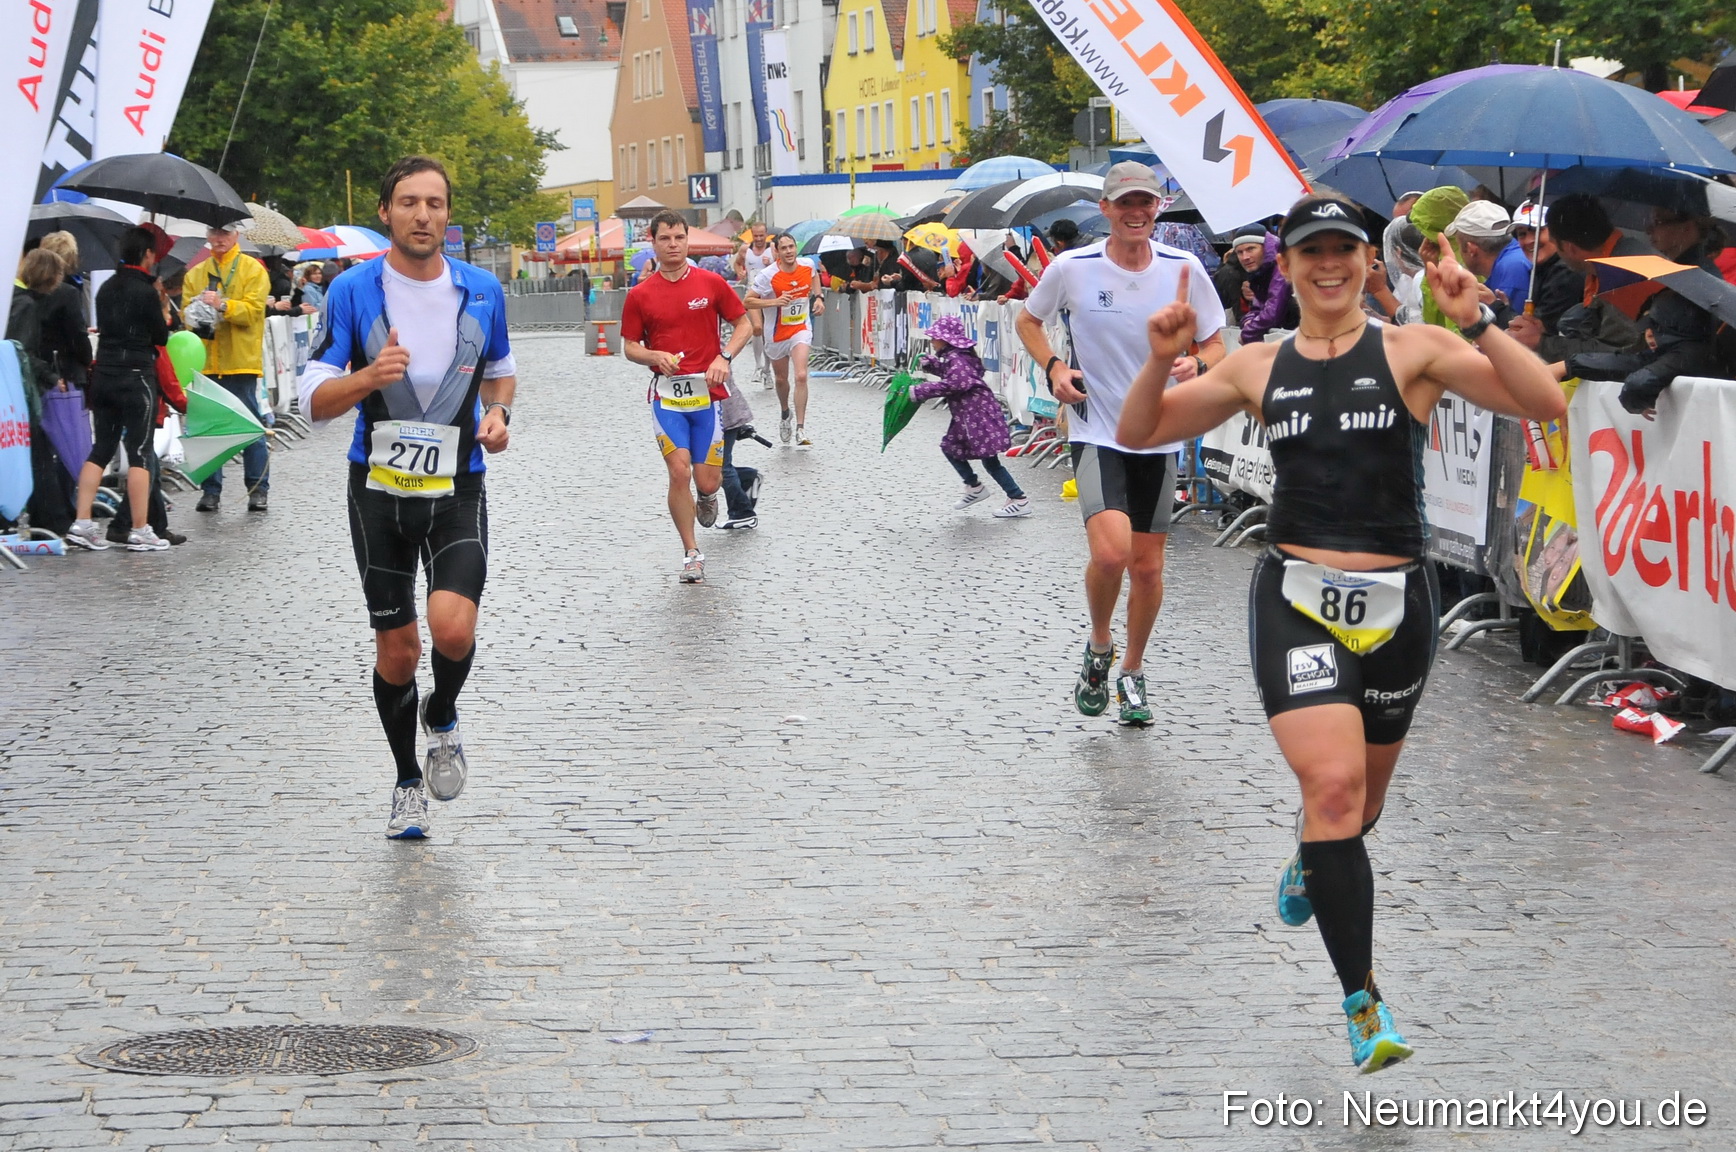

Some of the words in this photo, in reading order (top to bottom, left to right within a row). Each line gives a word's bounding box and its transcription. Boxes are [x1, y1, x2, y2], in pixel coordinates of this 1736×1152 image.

[123, 28, 167, 136] Audi
[858, 77, 878, 98] HOTEL
[790, 304, 802, 316] 87
[672, 381, 694, 398] 84
[1339, 403, 1397, 431] smit
[388, 441, 440, 475] 270
[1320, 586, 1368, 626] 86
[1294, 661, 1313, 672] TSV
[1295, 667, 1331, 682] SCHOTT
